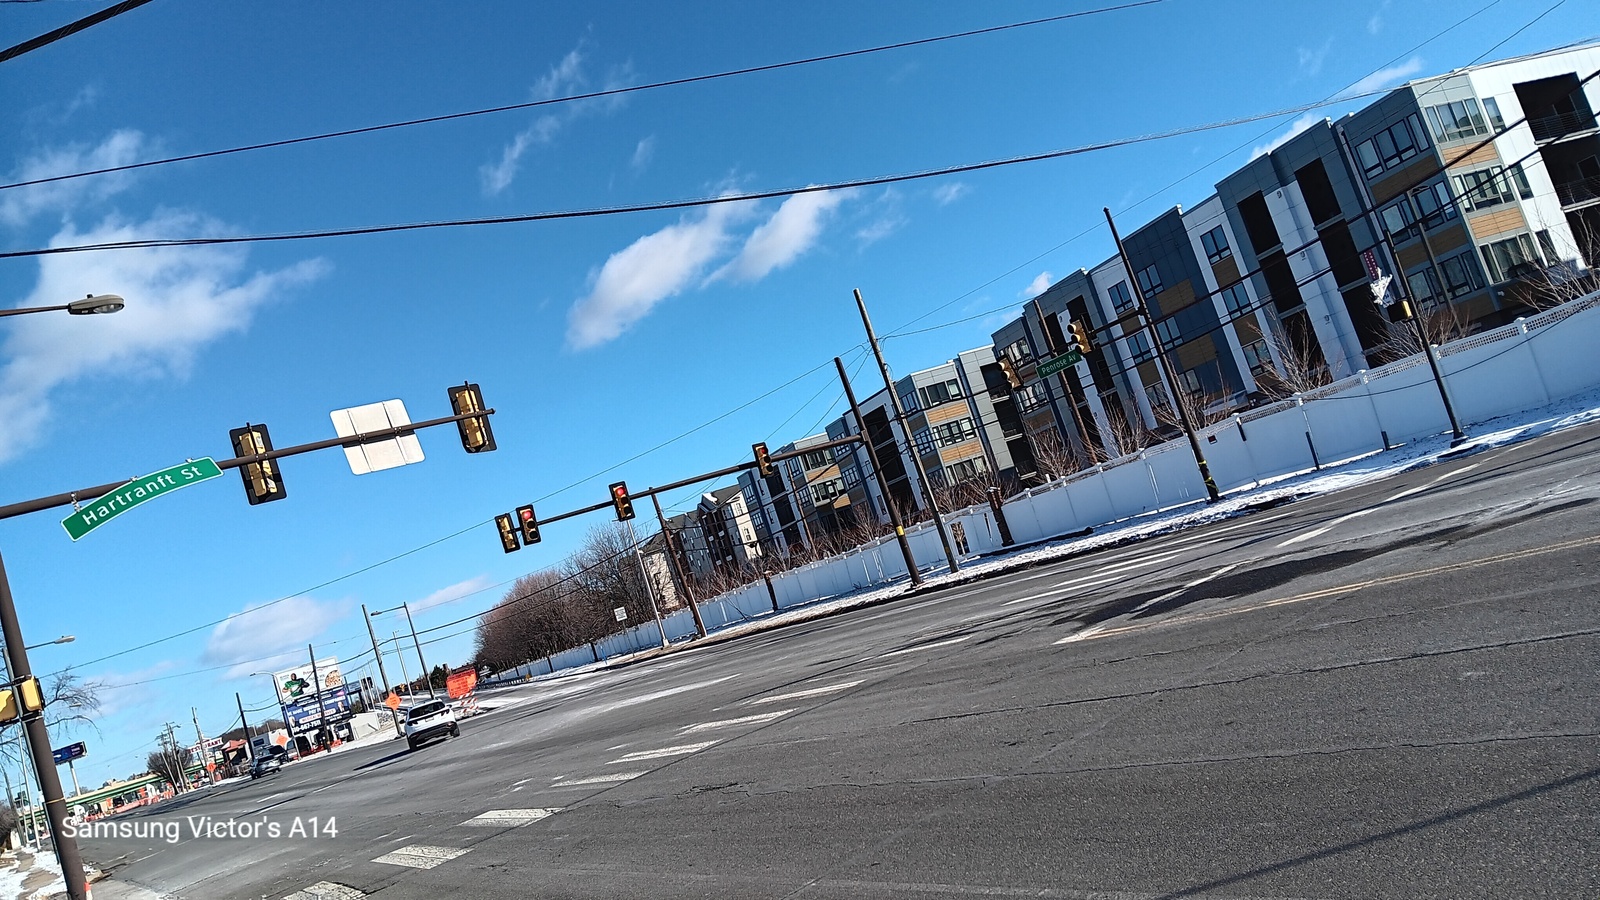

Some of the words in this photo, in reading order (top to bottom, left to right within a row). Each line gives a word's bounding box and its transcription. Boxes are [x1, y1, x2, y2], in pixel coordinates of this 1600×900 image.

[1041, 359, 1067, 374] Penrose
[1068, 354, 1076, 363] Av
[82, 474, 176, 525] Hartranft
[180, 465, 203, 480] St
